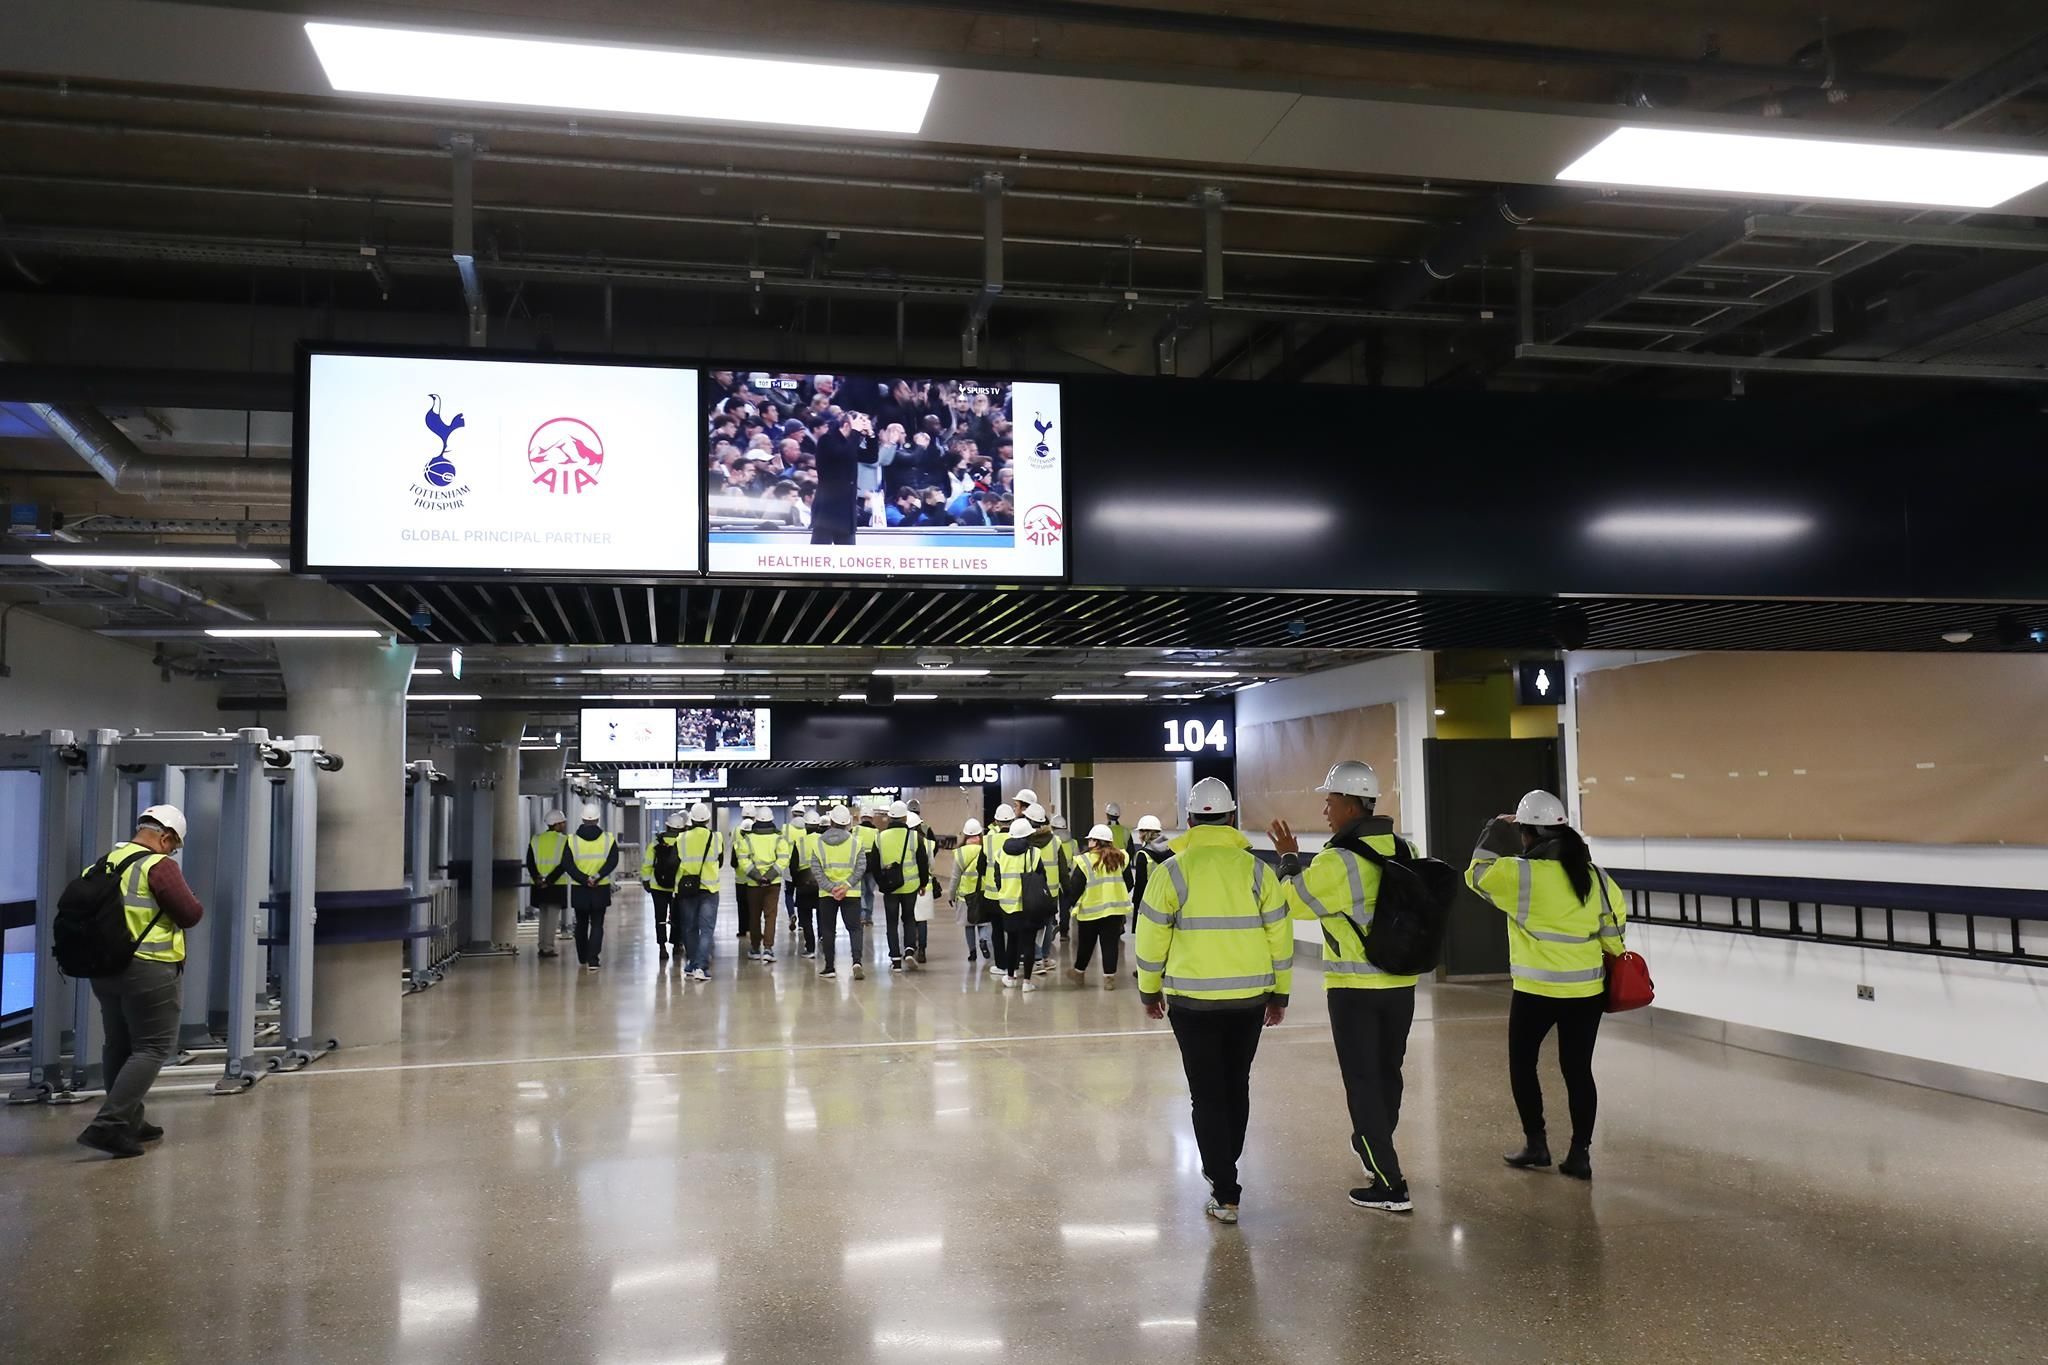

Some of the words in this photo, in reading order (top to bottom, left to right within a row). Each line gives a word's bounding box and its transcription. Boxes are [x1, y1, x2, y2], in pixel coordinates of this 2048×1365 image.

[967, 387, 989, 395] SPURS
[990, 387, 1000, 395] TV
[533, 468, 598, 494] AIA
[409, 484, 471, 500] TOTTENHAM
[414, 498, 465, 511] HOTSPUR
[401, 528, 459, 542] GLOBAL
[464, 529, 542, 544] PRINCIPAL
[545, 531, 612, 545] PARTNER
[1027, 532, 1059, 546] AIA
[758, 555, 835, 569] HEALTHIER,
[839, 557, 896, 569] LONGER,
[900, 557, 949, 569] BETTER
[952, 559, 988, 570] LIVES
[1163, 719, 1228, 752] 104
[959, 763, 999, 783] 105
